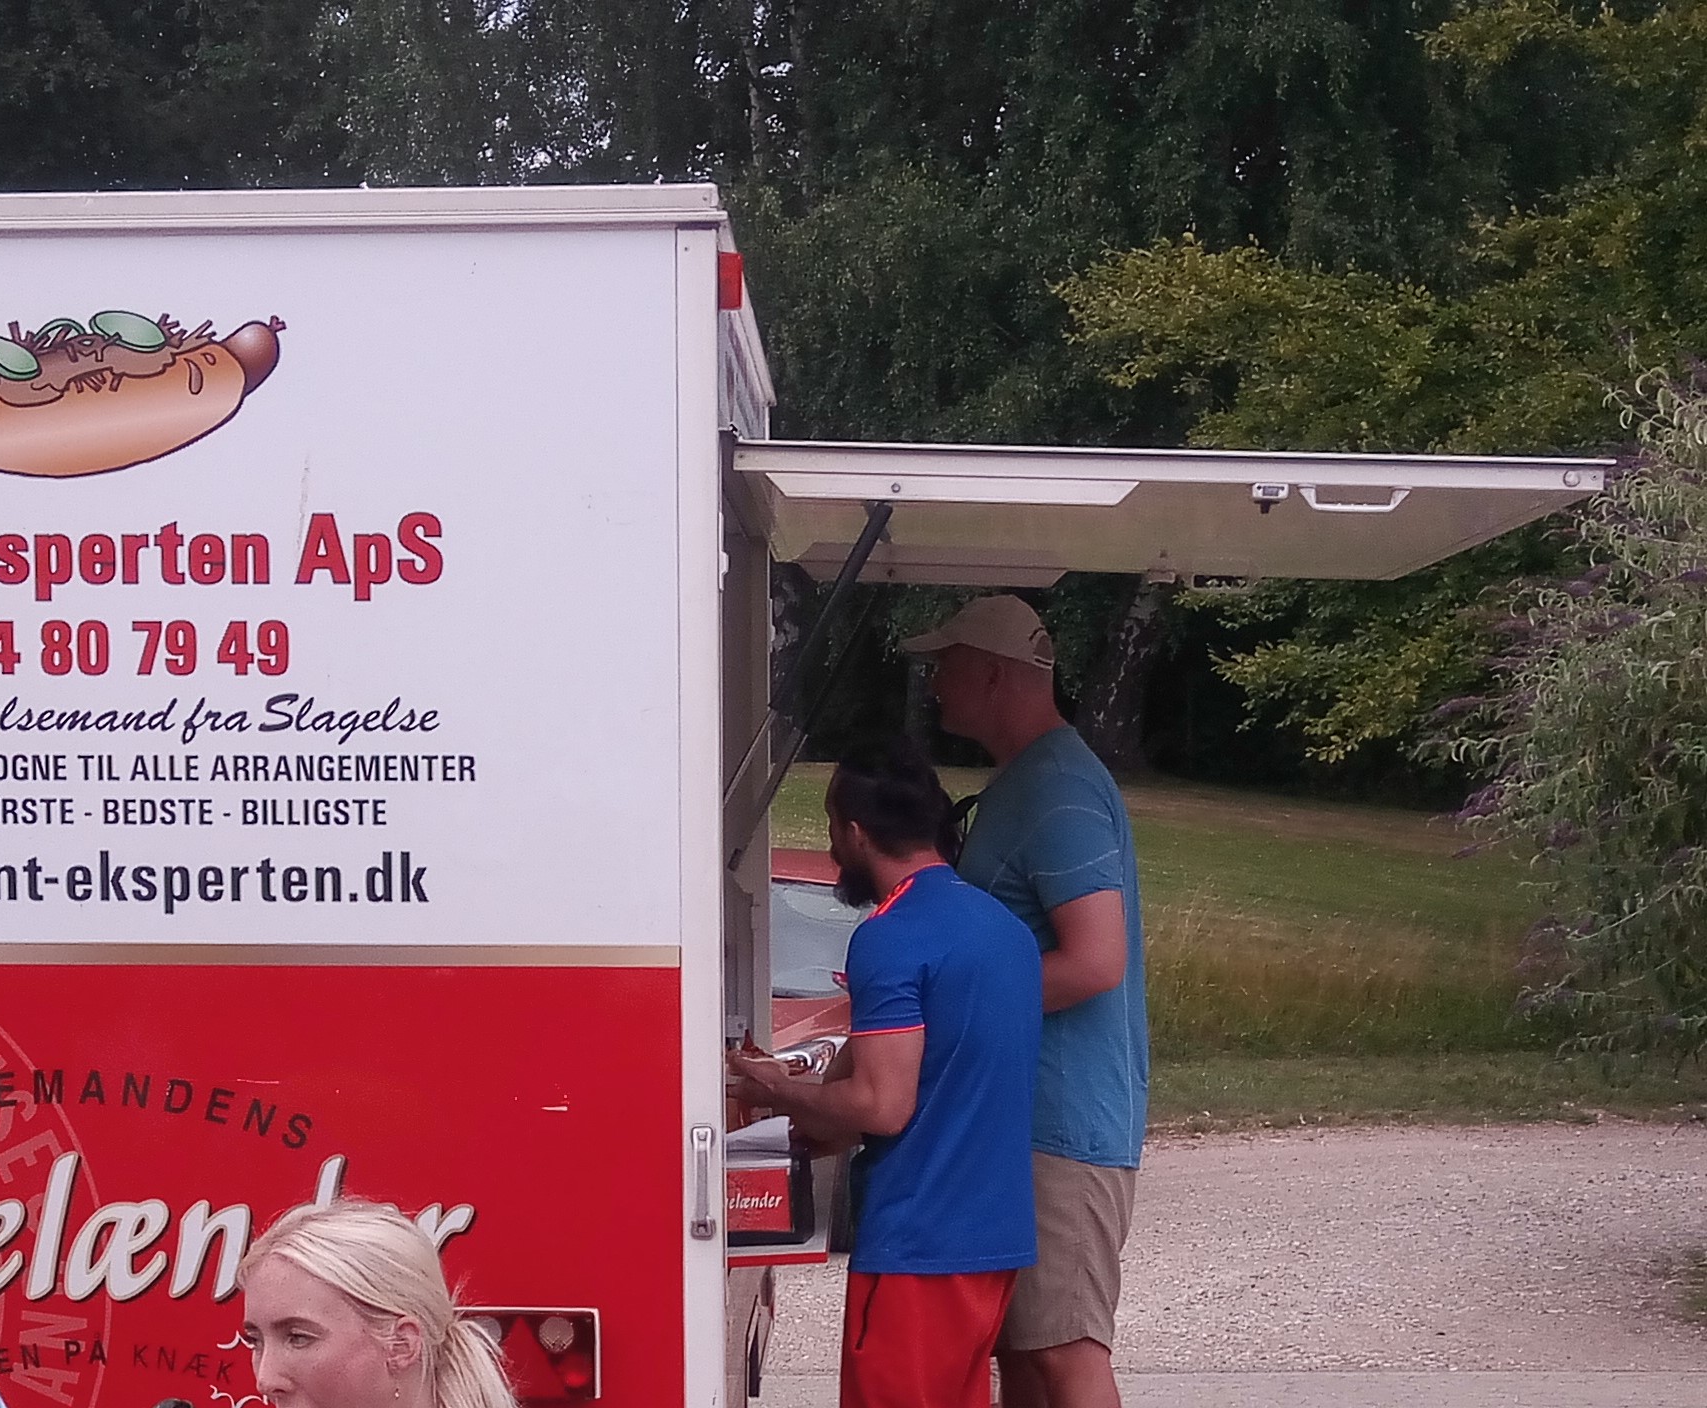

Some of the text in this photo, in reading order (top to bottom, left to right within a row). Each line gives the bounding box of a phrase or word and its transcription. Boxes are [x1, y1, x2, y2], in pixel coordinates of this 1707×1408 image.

[294, 511, 444, 602] ApS
[41, 619, 109, 677] 80
[132, 619, 197, 677] 79
[217, 619, 290, 677] 49
[181, 695, 252, 746] fra
[257, 692, 441, 746] Slagelse
[76, 754, 121, 782] TIL
[129, 754, 200, 782] ALLE
[209, 754, 477, 782] ARRANGEMENTER
[102, 798, 214, 826] BEDSTE
[241, 798, 388, 826] BILLIGSTE
[726, 1190, 783, 1210] elænder
[133, 1344, 236, 1384] KNÆK
